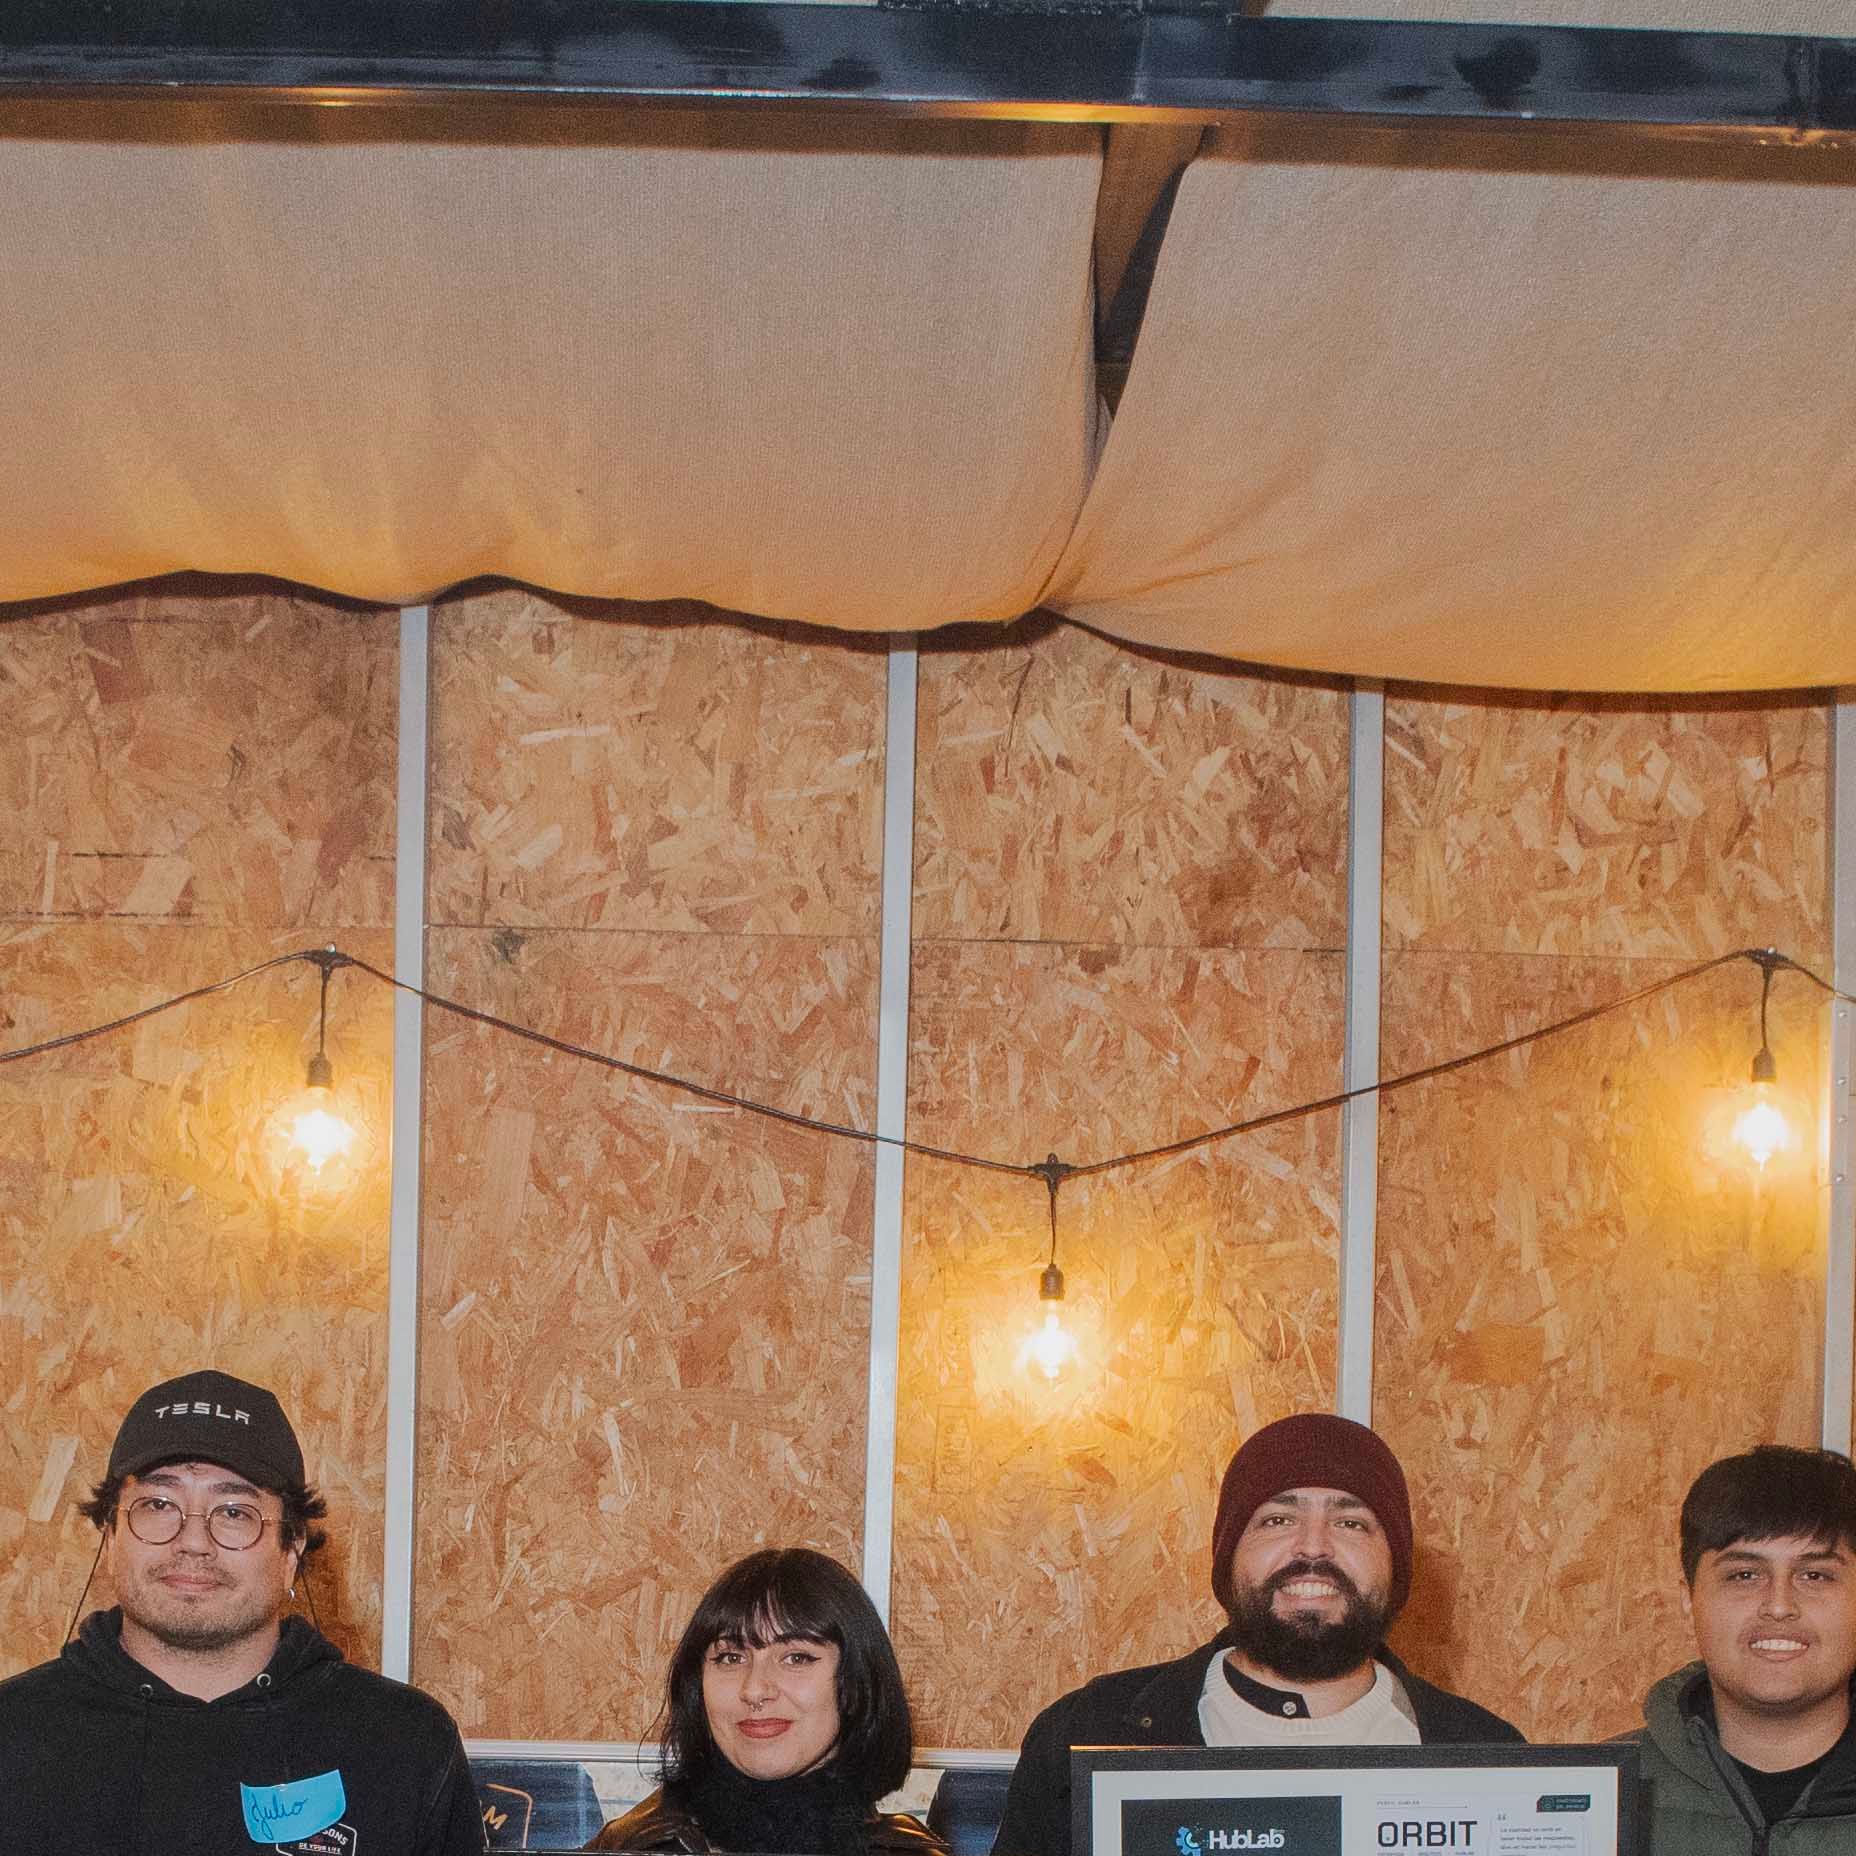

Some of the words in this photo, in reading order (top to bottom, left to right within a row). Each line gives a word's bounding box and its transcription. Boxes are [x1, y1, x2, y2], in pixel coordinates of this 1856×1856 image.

[155, 1402, 250, 1425] TESLA
[250, 1792, 309, 1840] Julio
[1209, 1828, 1285, 1849] HubLab
[1378, 1820, 1478, 1847] ORBIT
